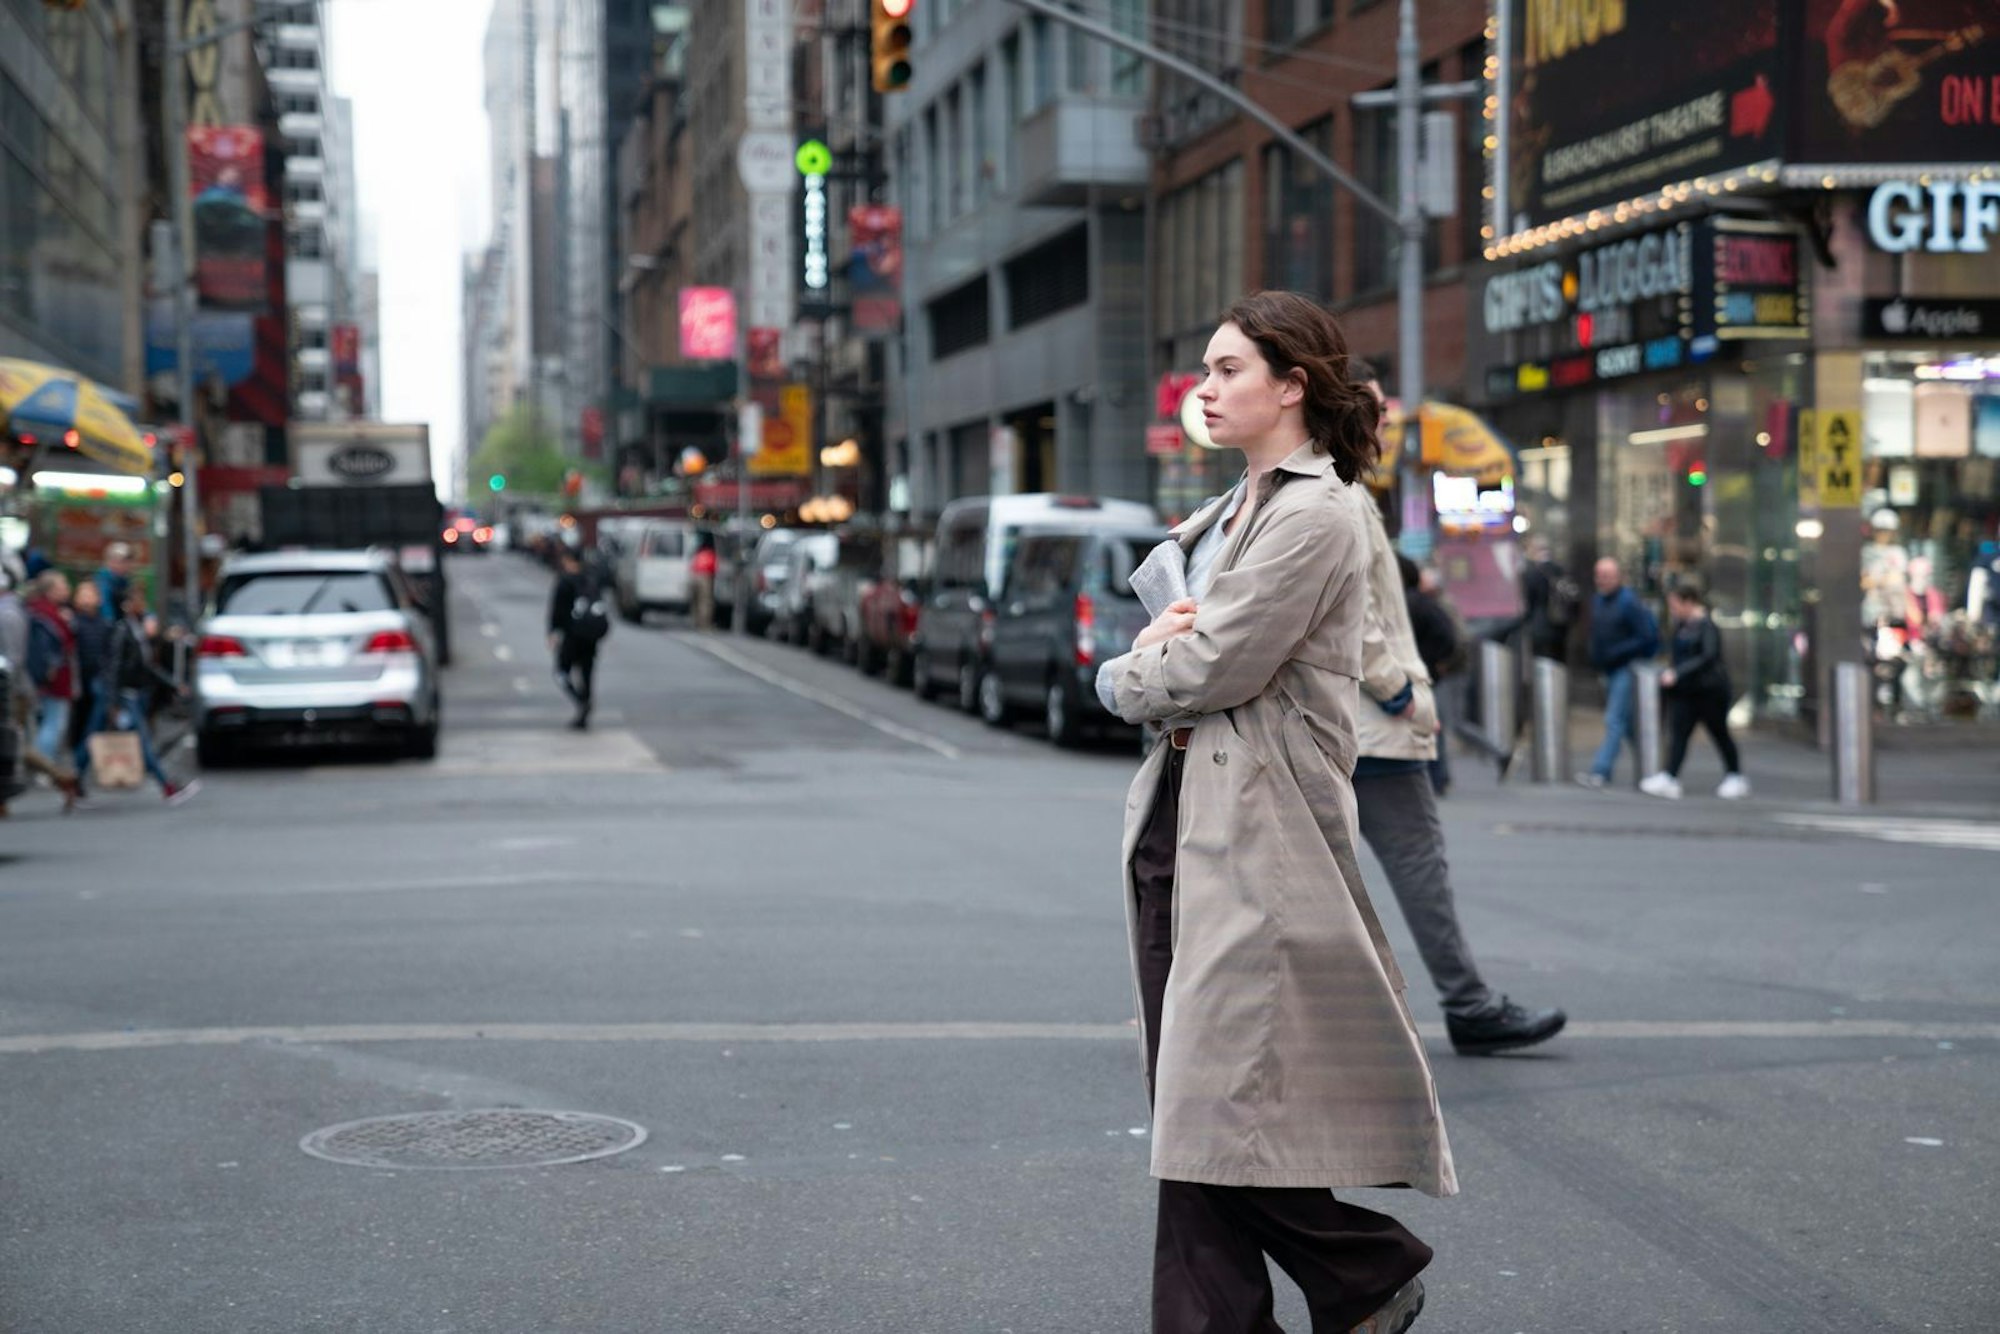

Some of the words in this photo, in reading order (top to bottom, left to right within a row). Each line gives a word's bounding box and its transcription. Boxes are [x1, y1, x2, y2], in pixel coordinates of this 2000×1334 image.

[1650, 90, 1724, 147] THEATRE
[1941, 75, 1984, 126] ON
[1910, 307, 1981, 336] Apple
[1827, 415, 1852, 488] ATM
